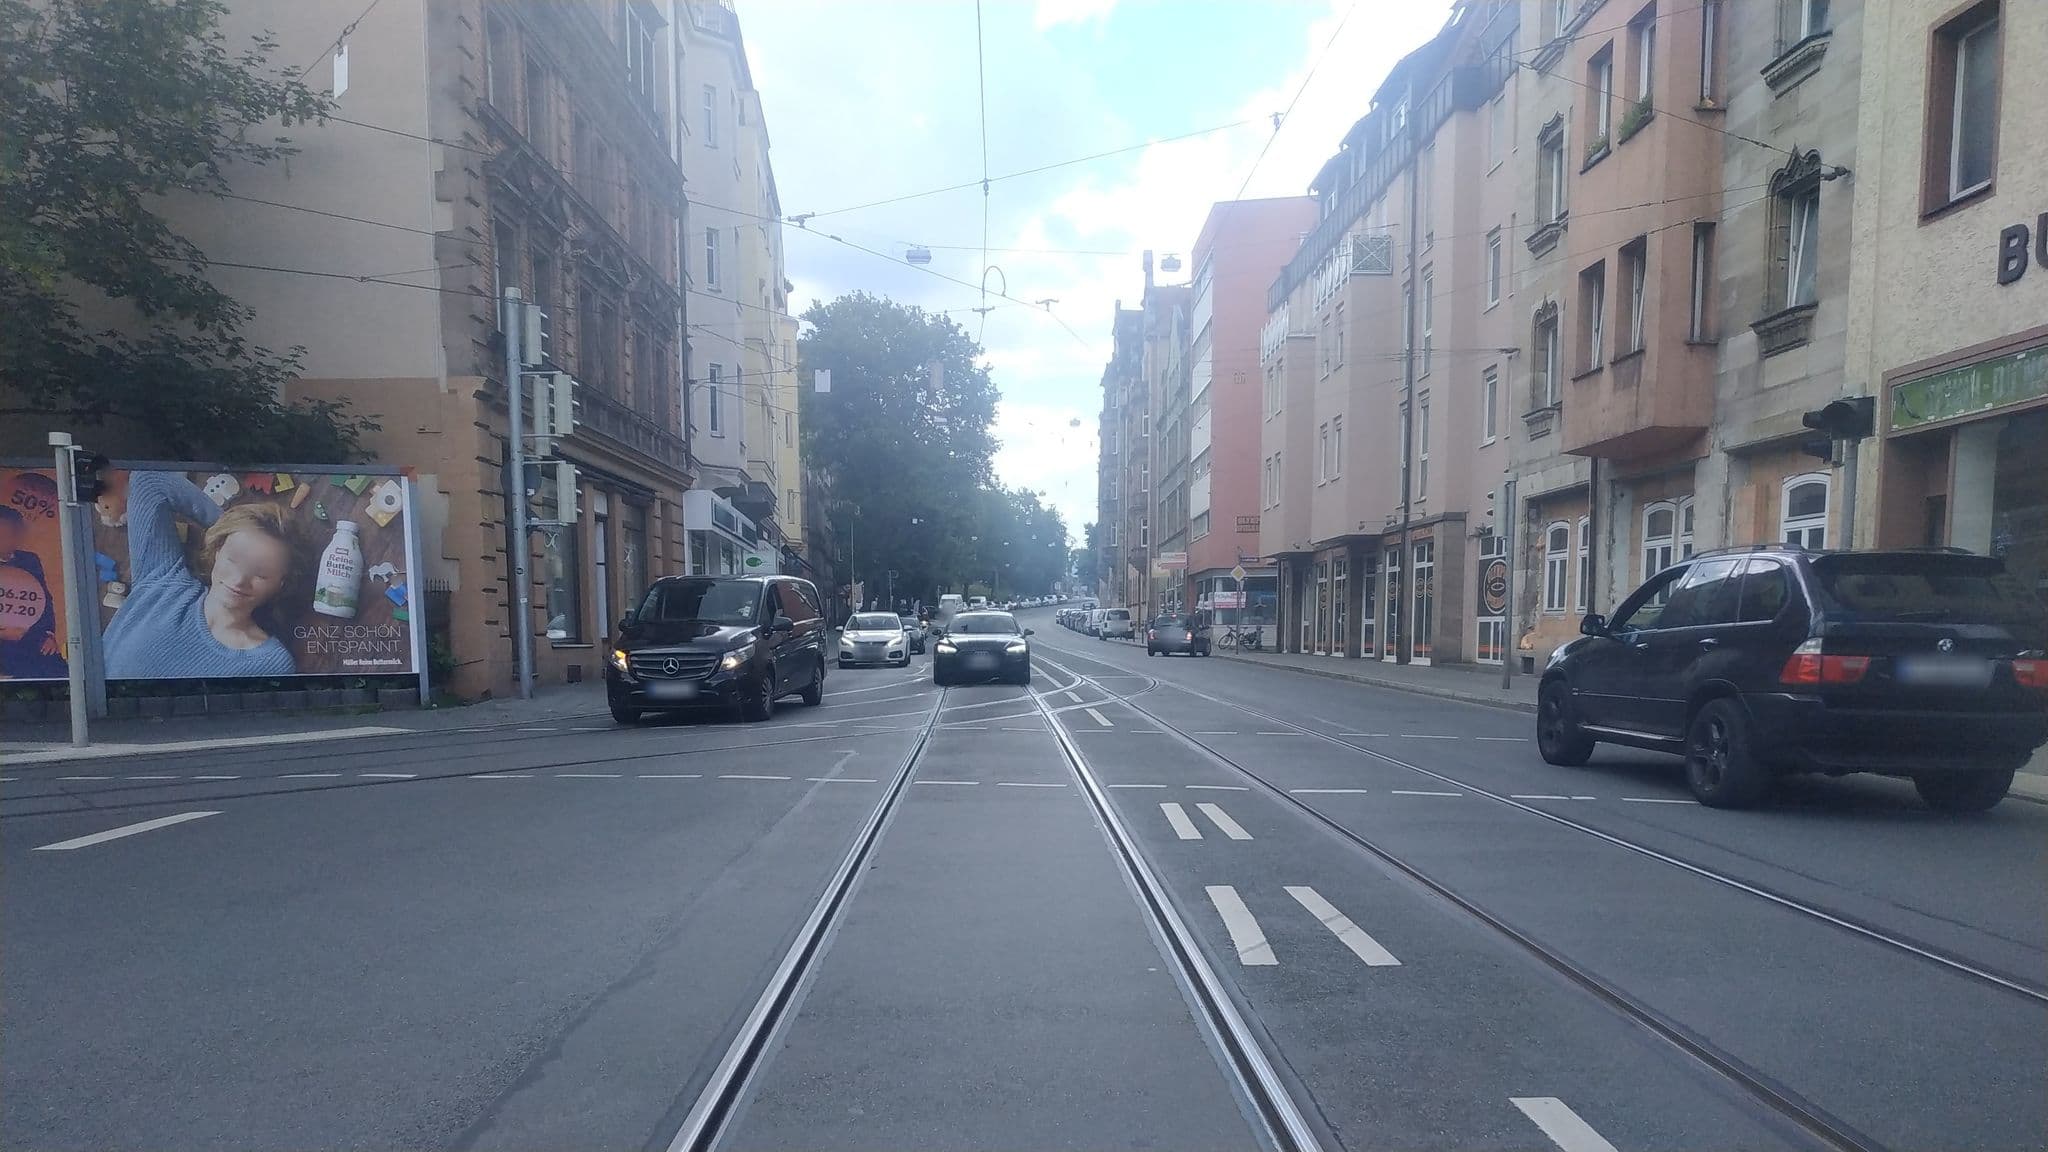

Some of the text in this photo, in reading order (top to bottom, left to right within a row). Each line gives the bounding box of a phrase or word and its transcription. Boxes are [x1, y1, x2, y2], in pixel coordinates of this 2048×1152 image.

[11, 489, 55, 518] 50%
[329, 553, 353, 565] Reine
[326, 560, 354, 573] Butter
[326, 567, 351, 579] Milch
[294, 624, 401, 639] GANZ SCHÖN
[307, 640, 402, 653] ENTSPANNT.
